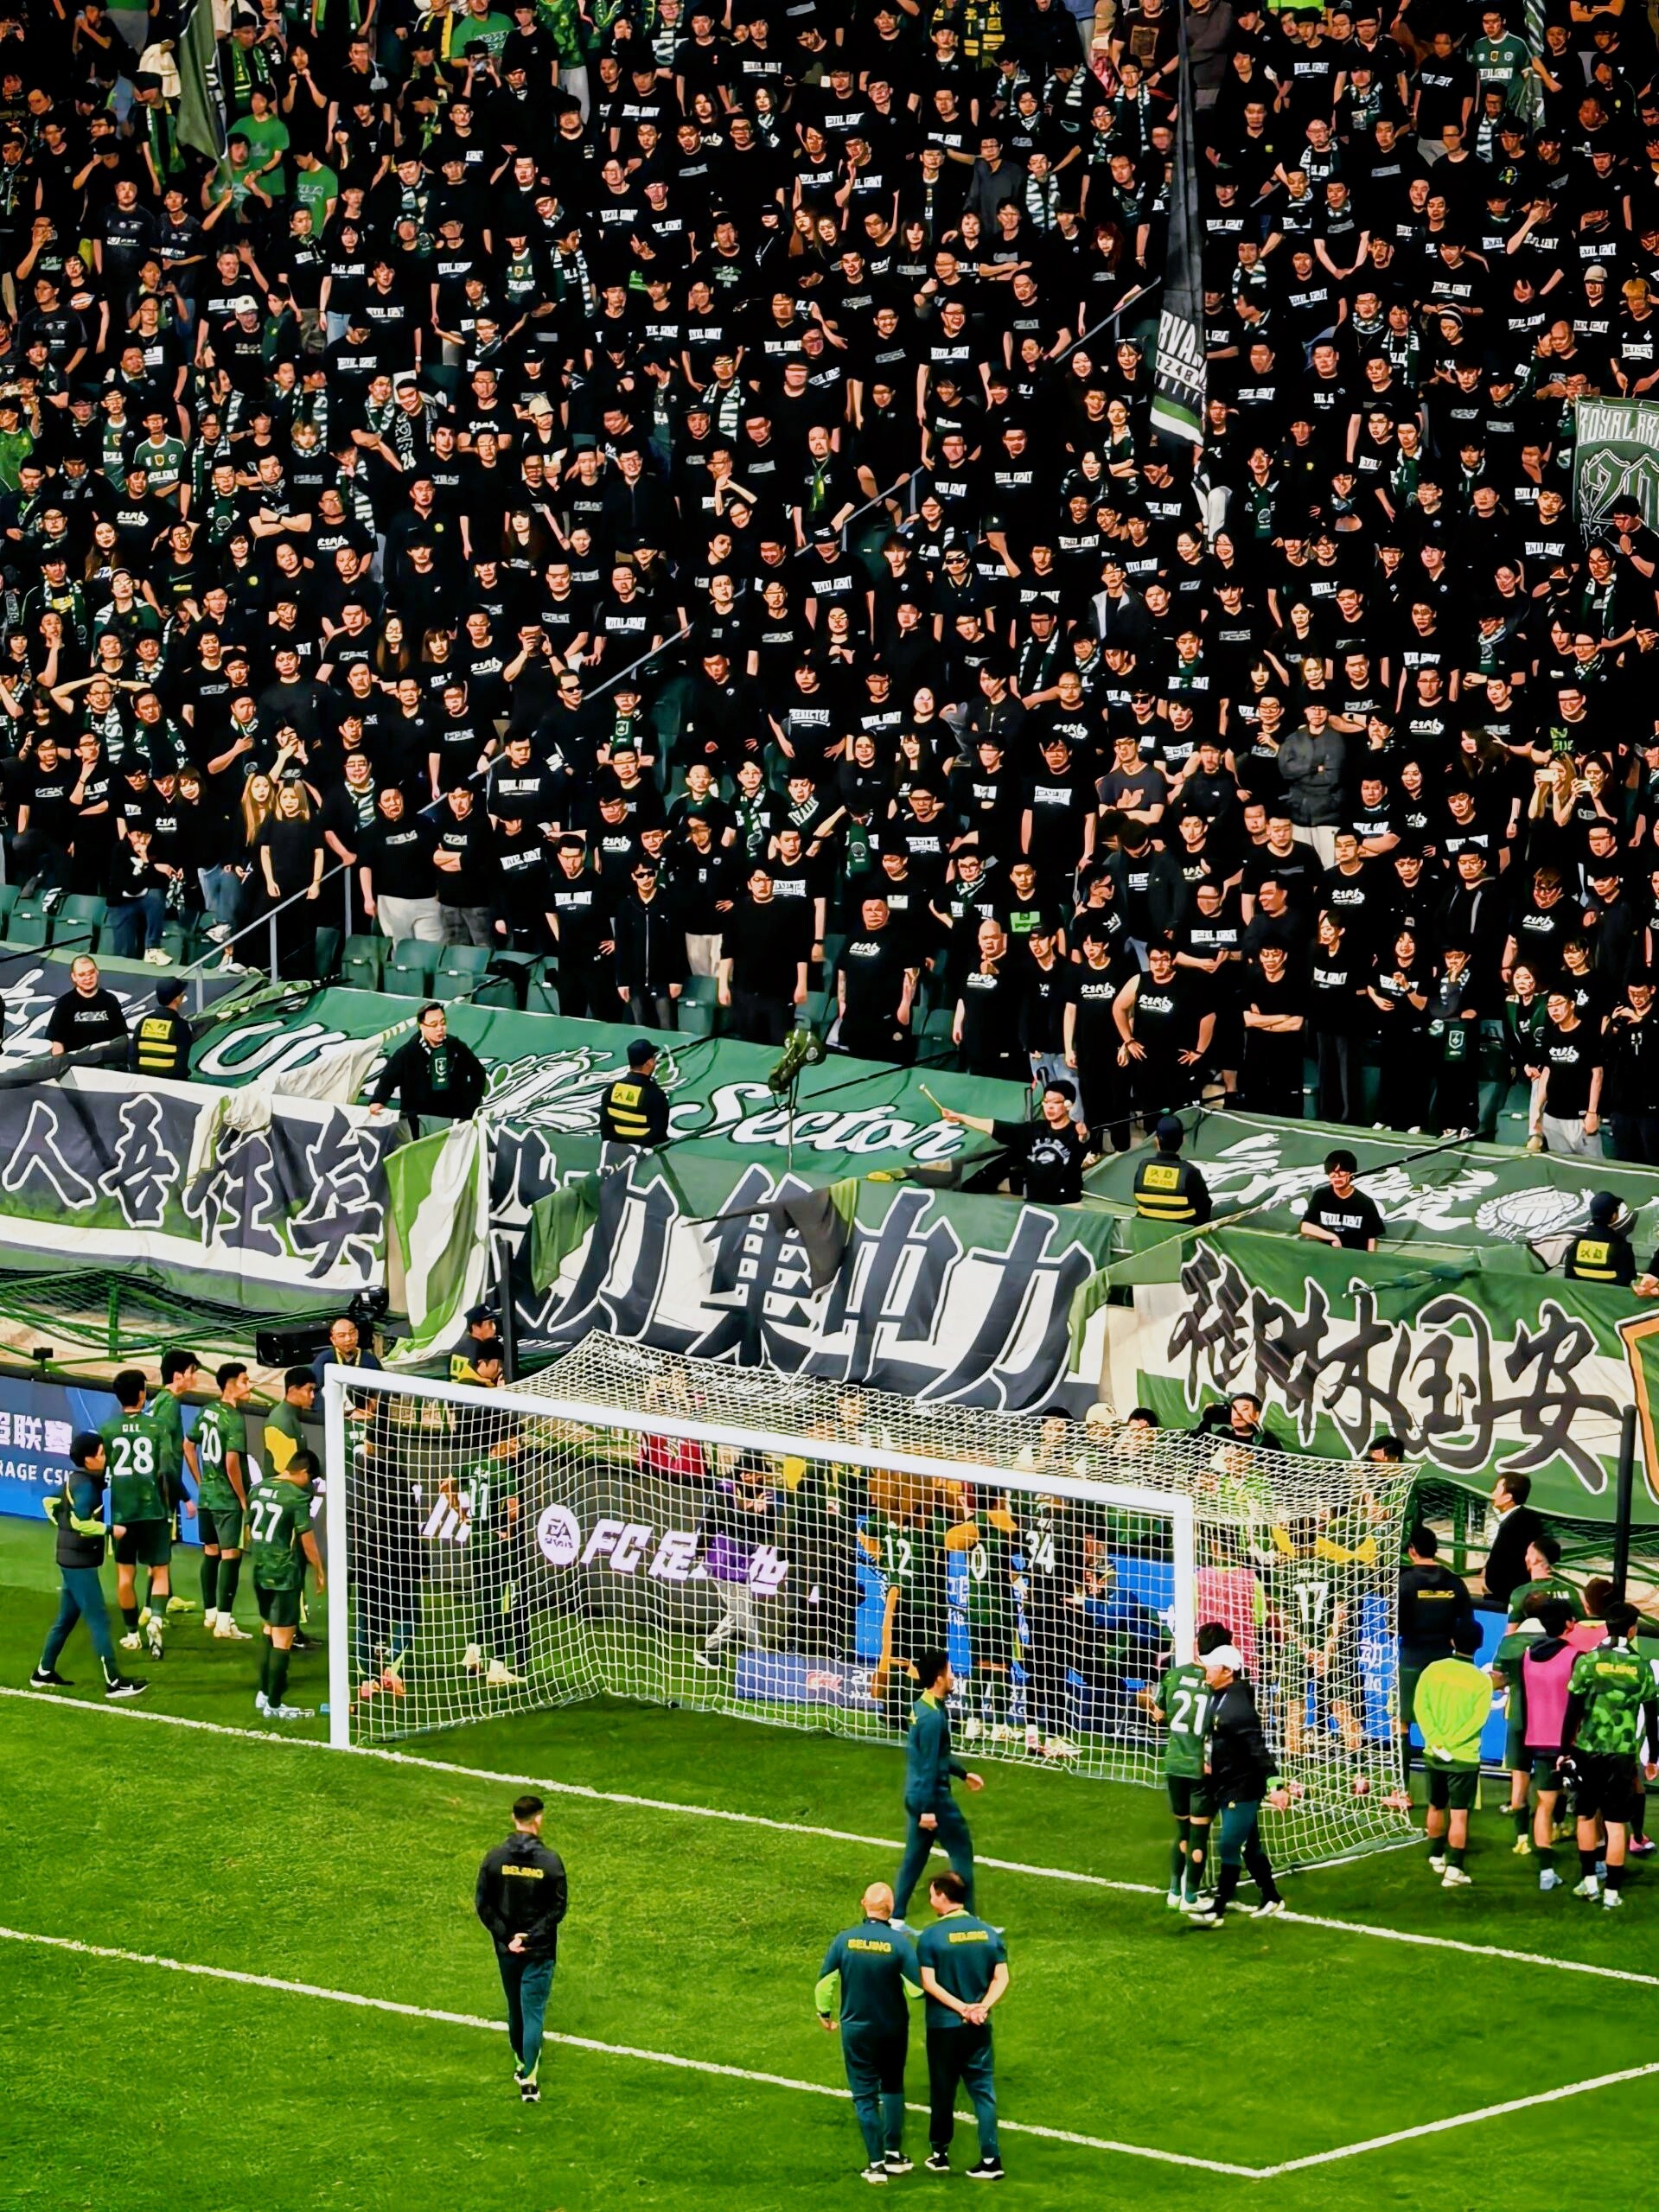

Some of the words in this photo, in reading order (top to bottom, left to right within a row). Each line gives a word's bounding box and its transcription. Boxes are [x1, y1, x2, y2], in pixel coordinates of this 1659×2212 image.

[1579, 405, 1635, 445] ROYAL
[667, 1081, 965, 1160] Sector
[112, 1437, 154, 1476] 28
[199, 1422, 221, 1464] 20
[249, 1500, 284, 1542] 27
[884, 1534, 914, 1578] 12
[1292, 1582, 1330, 1623] 17
[1170, 1690, 1209, 1736] 21
[847, 1938, 891, 1953] BEIJING
